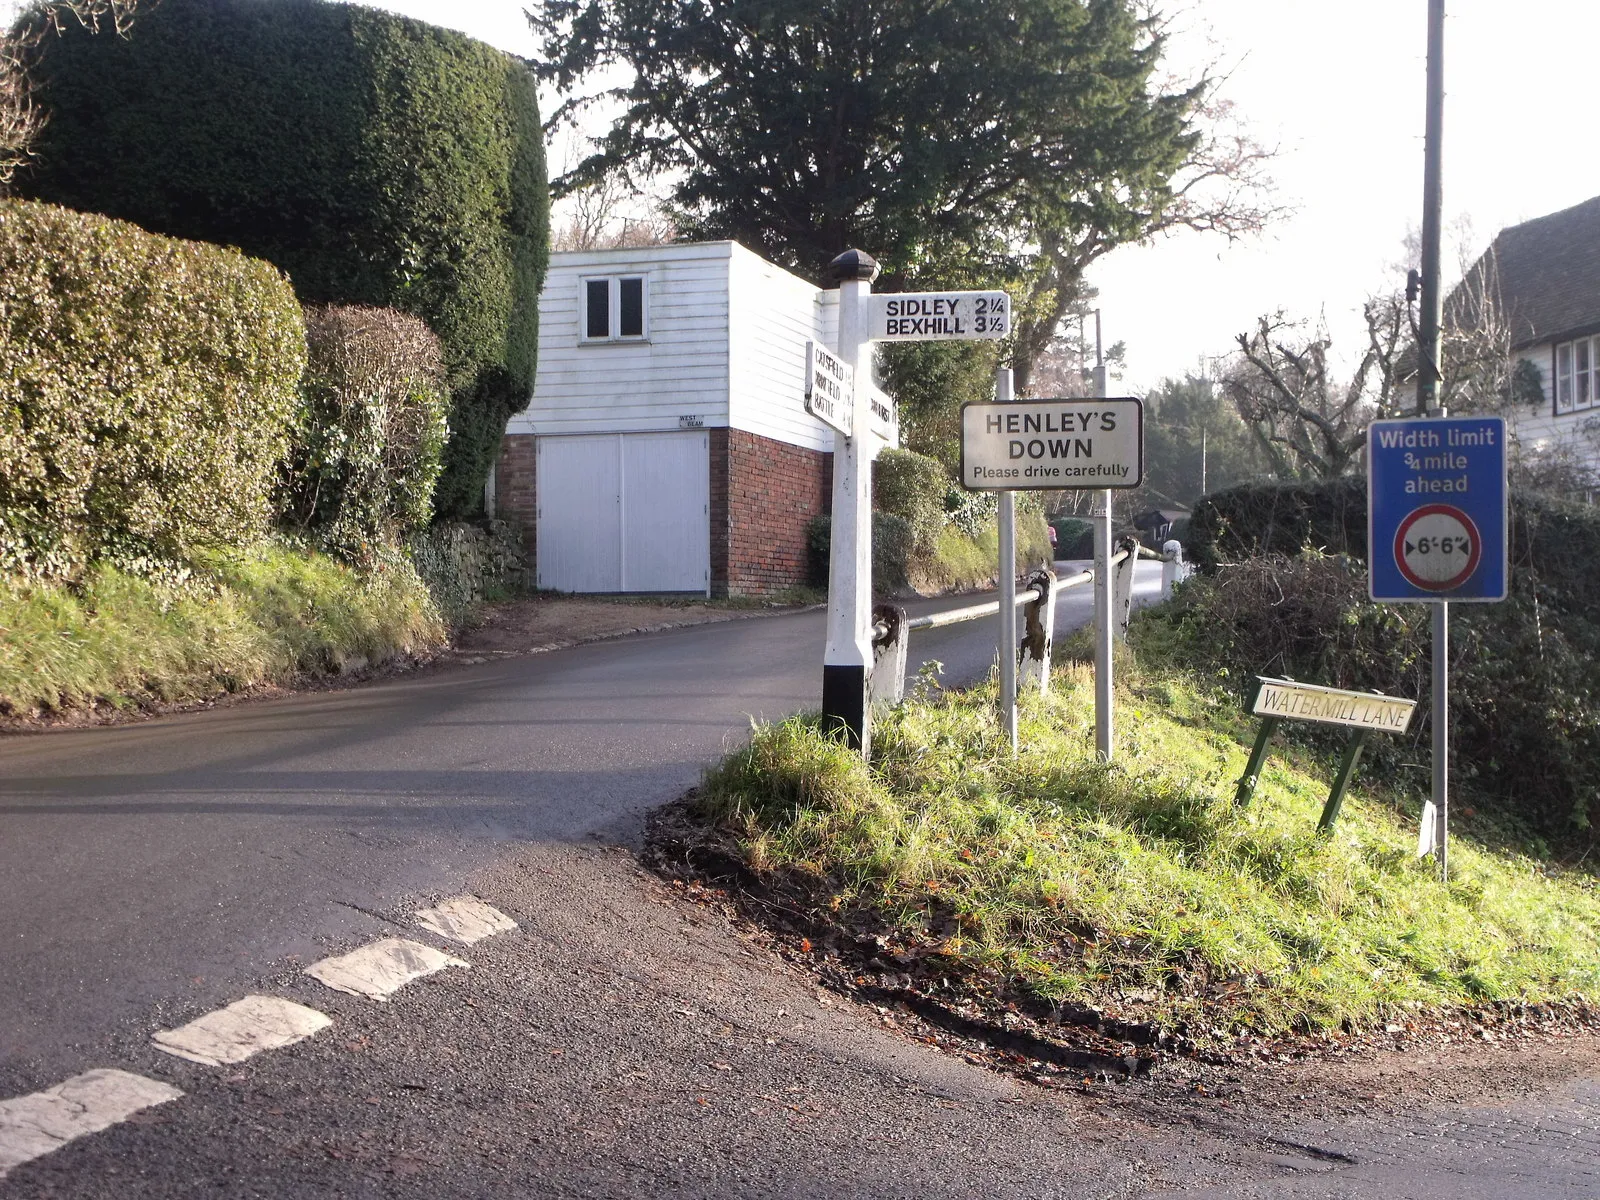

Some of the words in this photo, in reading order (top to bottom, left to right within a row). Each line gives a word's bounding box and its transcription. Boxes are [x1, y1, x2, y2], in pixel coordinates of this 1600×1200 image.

[886, 299, 960, 316] SIDLEY
[886, 317, 965, 335] BEXHILL
[986, 411, 1117, 434] HENLEY'S
[1379, 430, 1439, 449] Width
[1448, 428, 1495, 446] limit
[1009, 438, 1093, 460] DOWN
[1424, 453, 1468, 470] mile
[973, 466, 1020, 479] Please
[1024, 465, 1060, 477] drive
[1065, 464, 1130, 478] carefully
[1405, 475, 1468, 493] ahead
[1263, 689, 1357, 721] WATERMILL
[1362, 703, 1408, 727] LANE
